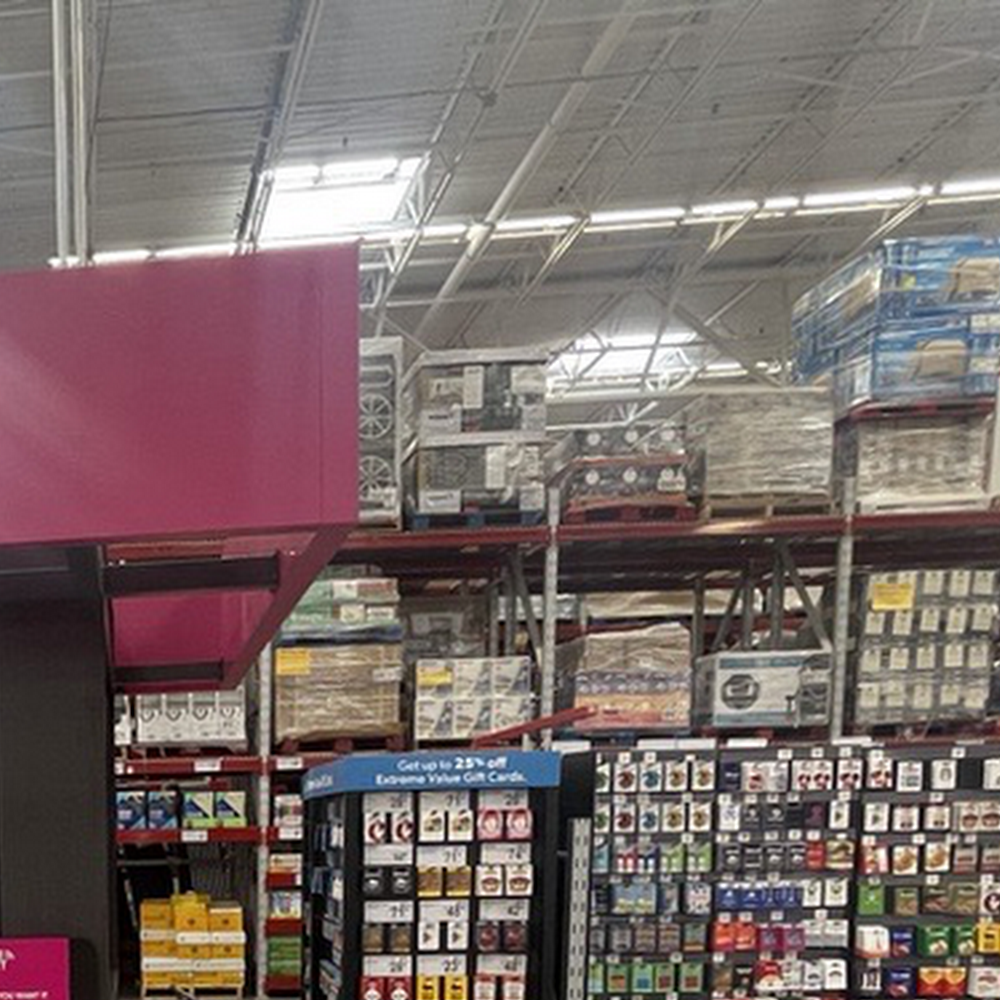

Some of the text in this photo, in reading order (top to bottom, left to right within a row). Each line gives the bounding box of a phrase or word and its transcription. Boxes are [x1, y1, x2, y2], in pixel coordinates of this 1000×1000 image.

[397, 759, 419, 772] Get
[421, 760, 438, 773] up
[440, 759, 453, 771] to
[487, 756, 508, 769] off
[375, 773, 425, 785] Extreme
[426, 772, 461, 784] Value
[463, 771, 485, 783] Gift
